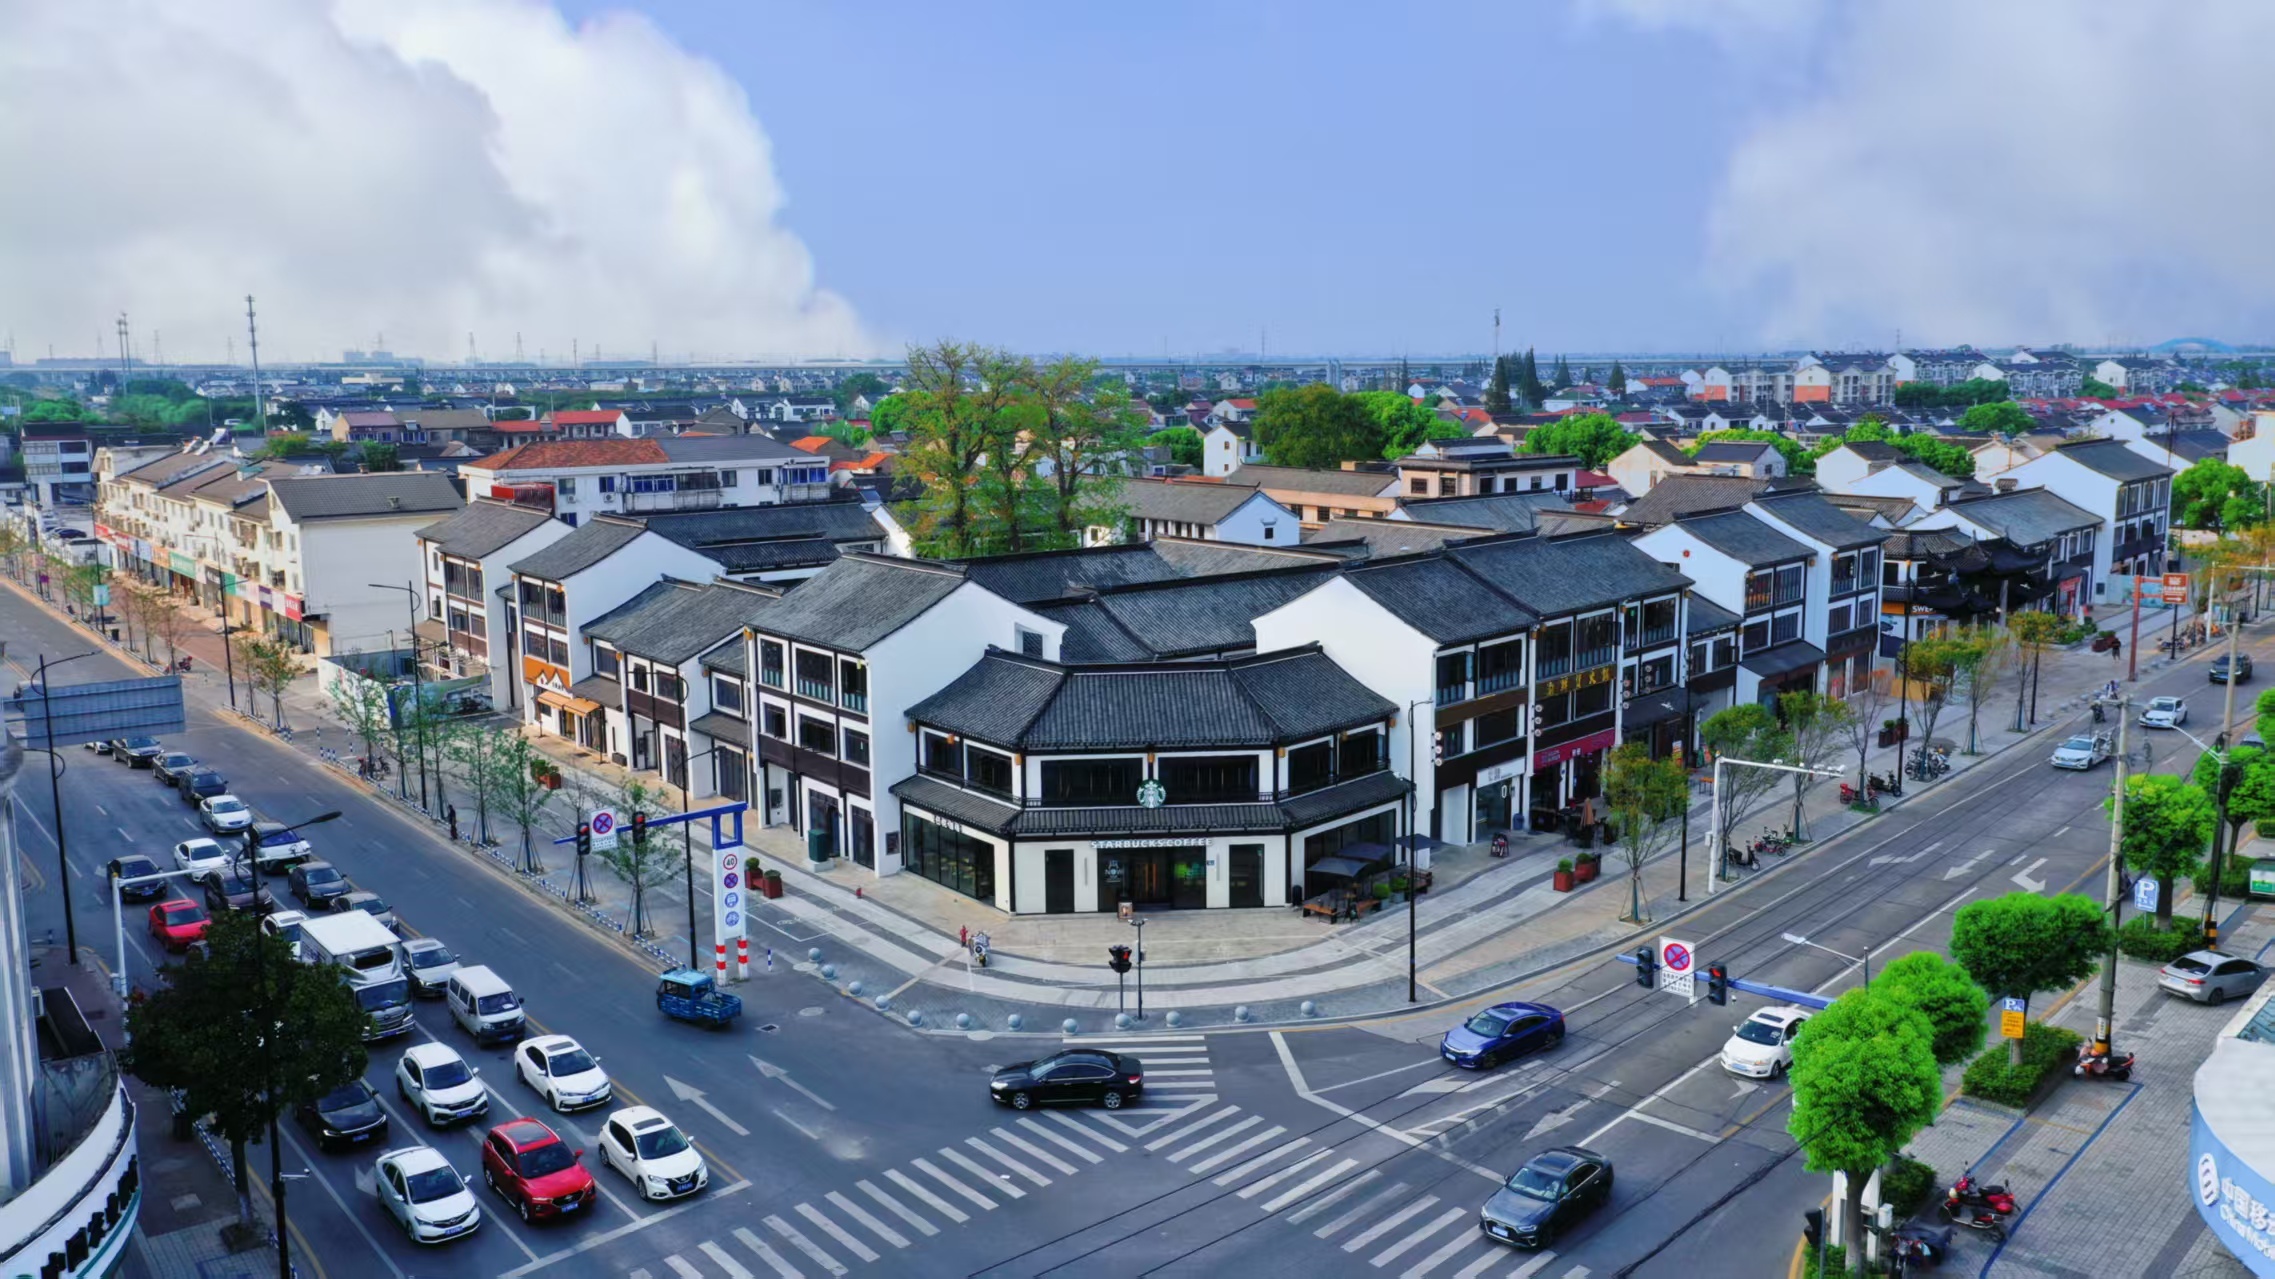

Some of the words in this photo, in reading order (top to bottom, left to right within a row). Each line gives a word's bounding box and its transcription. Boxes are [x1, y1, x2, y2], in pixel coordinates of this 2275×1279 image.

[1091, 839, 1164, 849] STARBUCKS
[1166, 838, 1213, 847] COFFEE
[2138, 881, 2155, 898] P
[2004, 999, 2016, 1010] P
